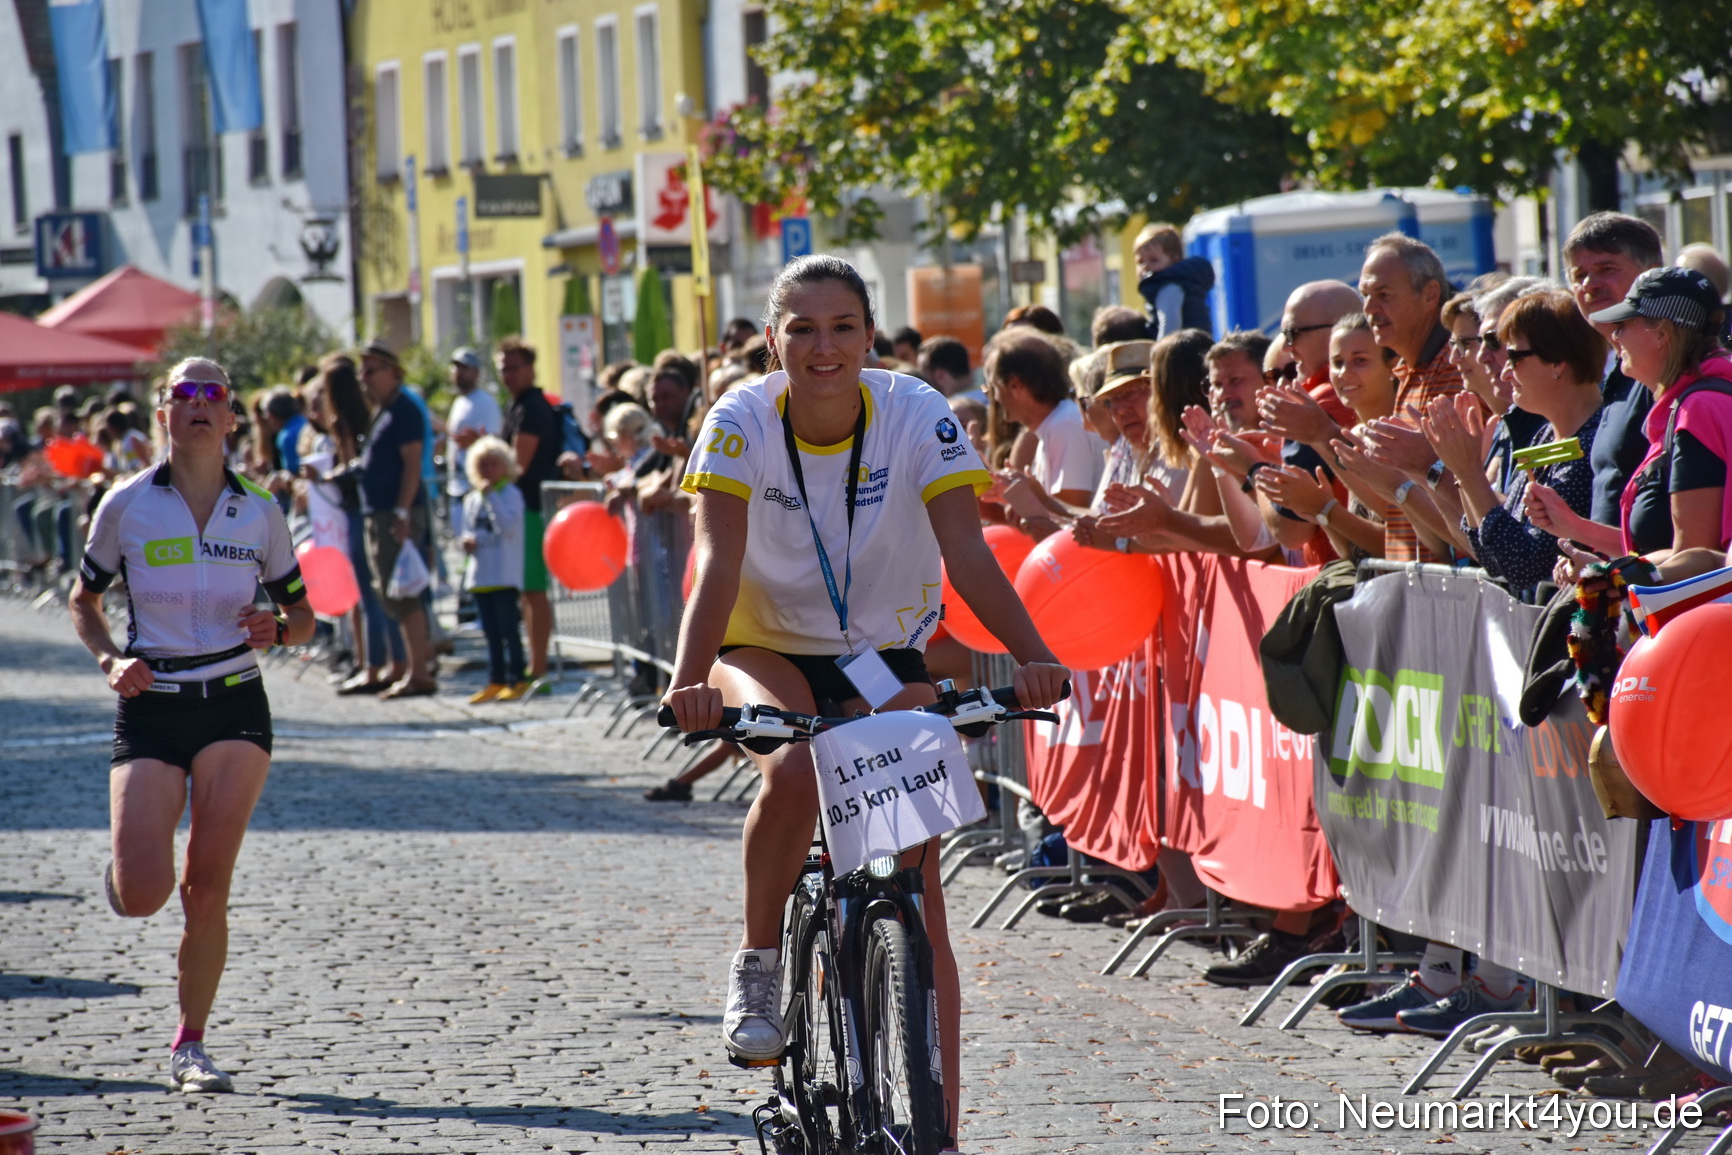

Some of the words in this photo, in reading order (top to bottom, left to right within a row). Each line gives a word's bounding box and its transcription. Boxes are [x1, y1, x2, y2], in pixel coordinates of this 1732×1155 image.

[705, 427, 744, 459] 20
[155, 544, 184, 560] CIS
[921, 611, 938, 627] 2019
[1333, 680, 1443, 774] BOCK
[835, 748, 902, 785] 1.Frau
[827, 797, 860, 827] 10,5
[863, 785, 899, 810] km
[901, 760, 948, 794] Lauf
[1689, 1000, 1732, 1067] GET
